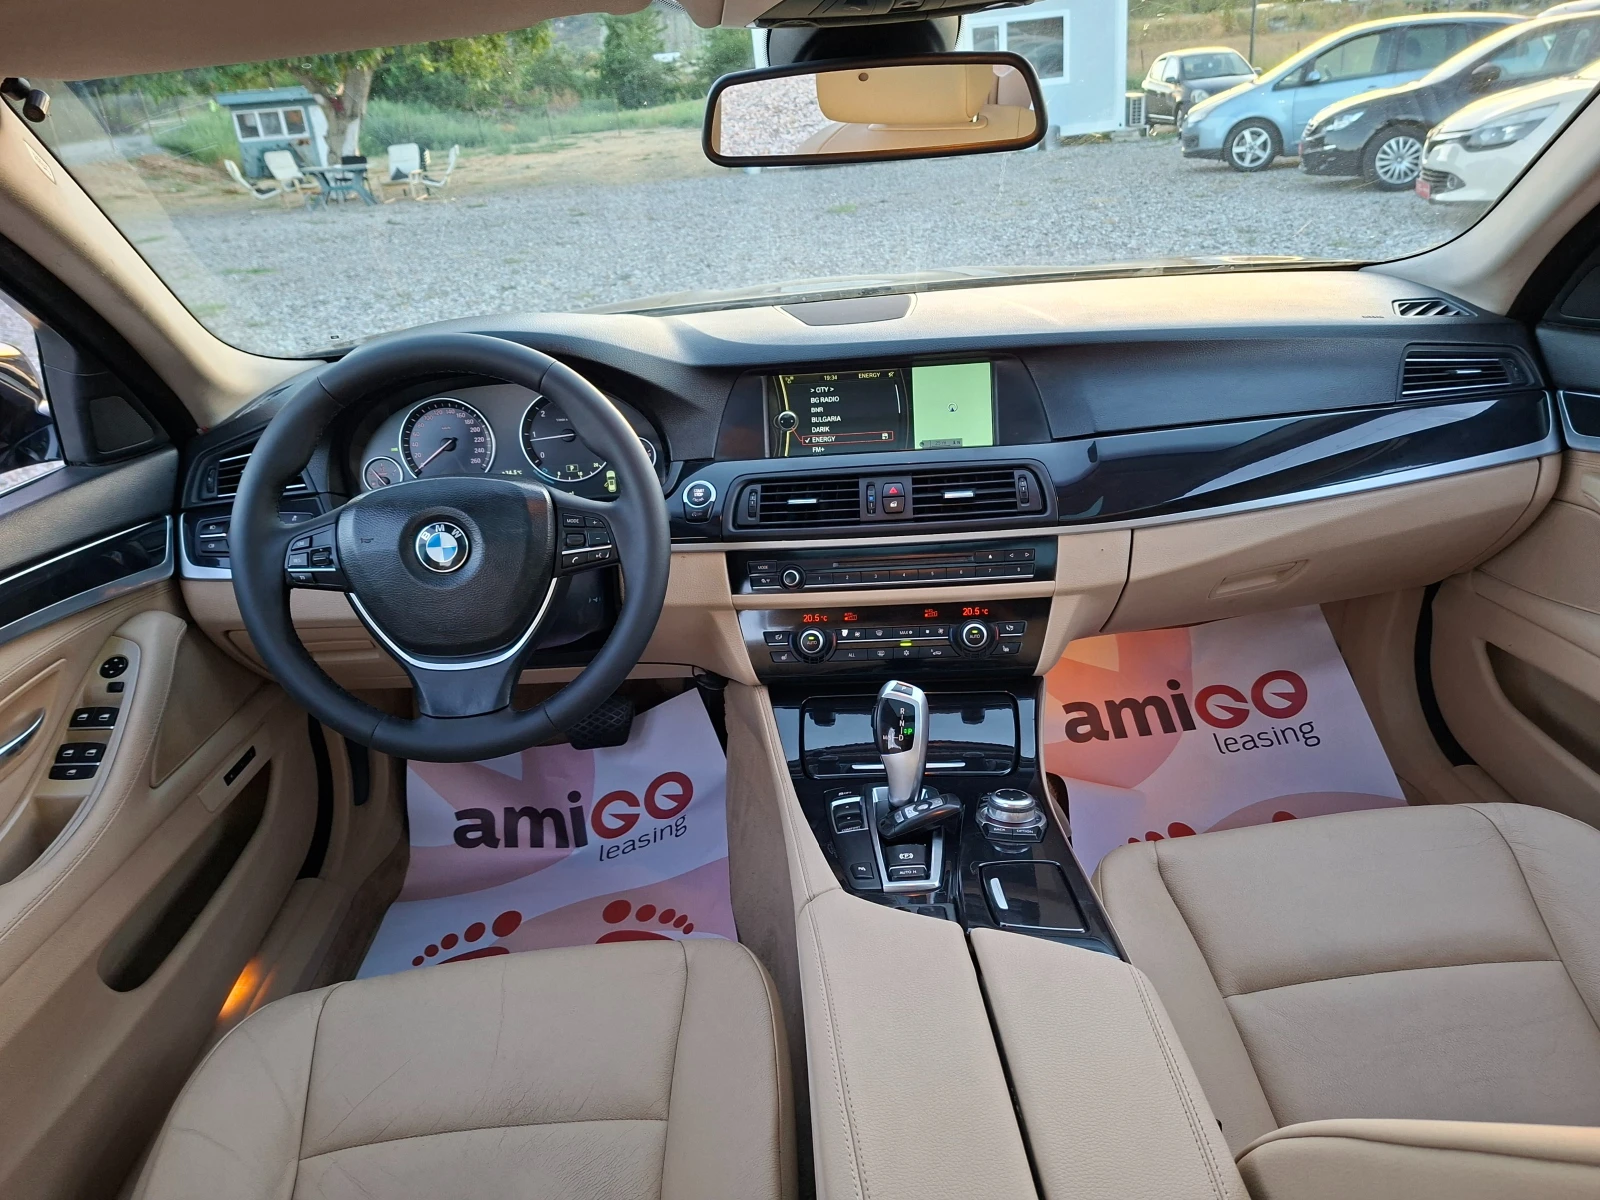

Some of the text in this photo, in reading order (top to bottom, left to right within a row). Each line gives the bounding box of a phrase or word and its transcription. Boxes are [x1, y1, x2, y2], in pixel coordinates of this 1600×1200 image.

[540, 410, 546, 418] 2
[811, 415, 842, 423] BULGARIA
[811, 435, 836, 443] ENERGY
[540, 451, 545, 459] 0
[420, 524, 462, 541] BMW
[900, 707, 905, 715] R
[1212, 720, 1321, 755] leasing
[599, 814, 688, 862] leasing
